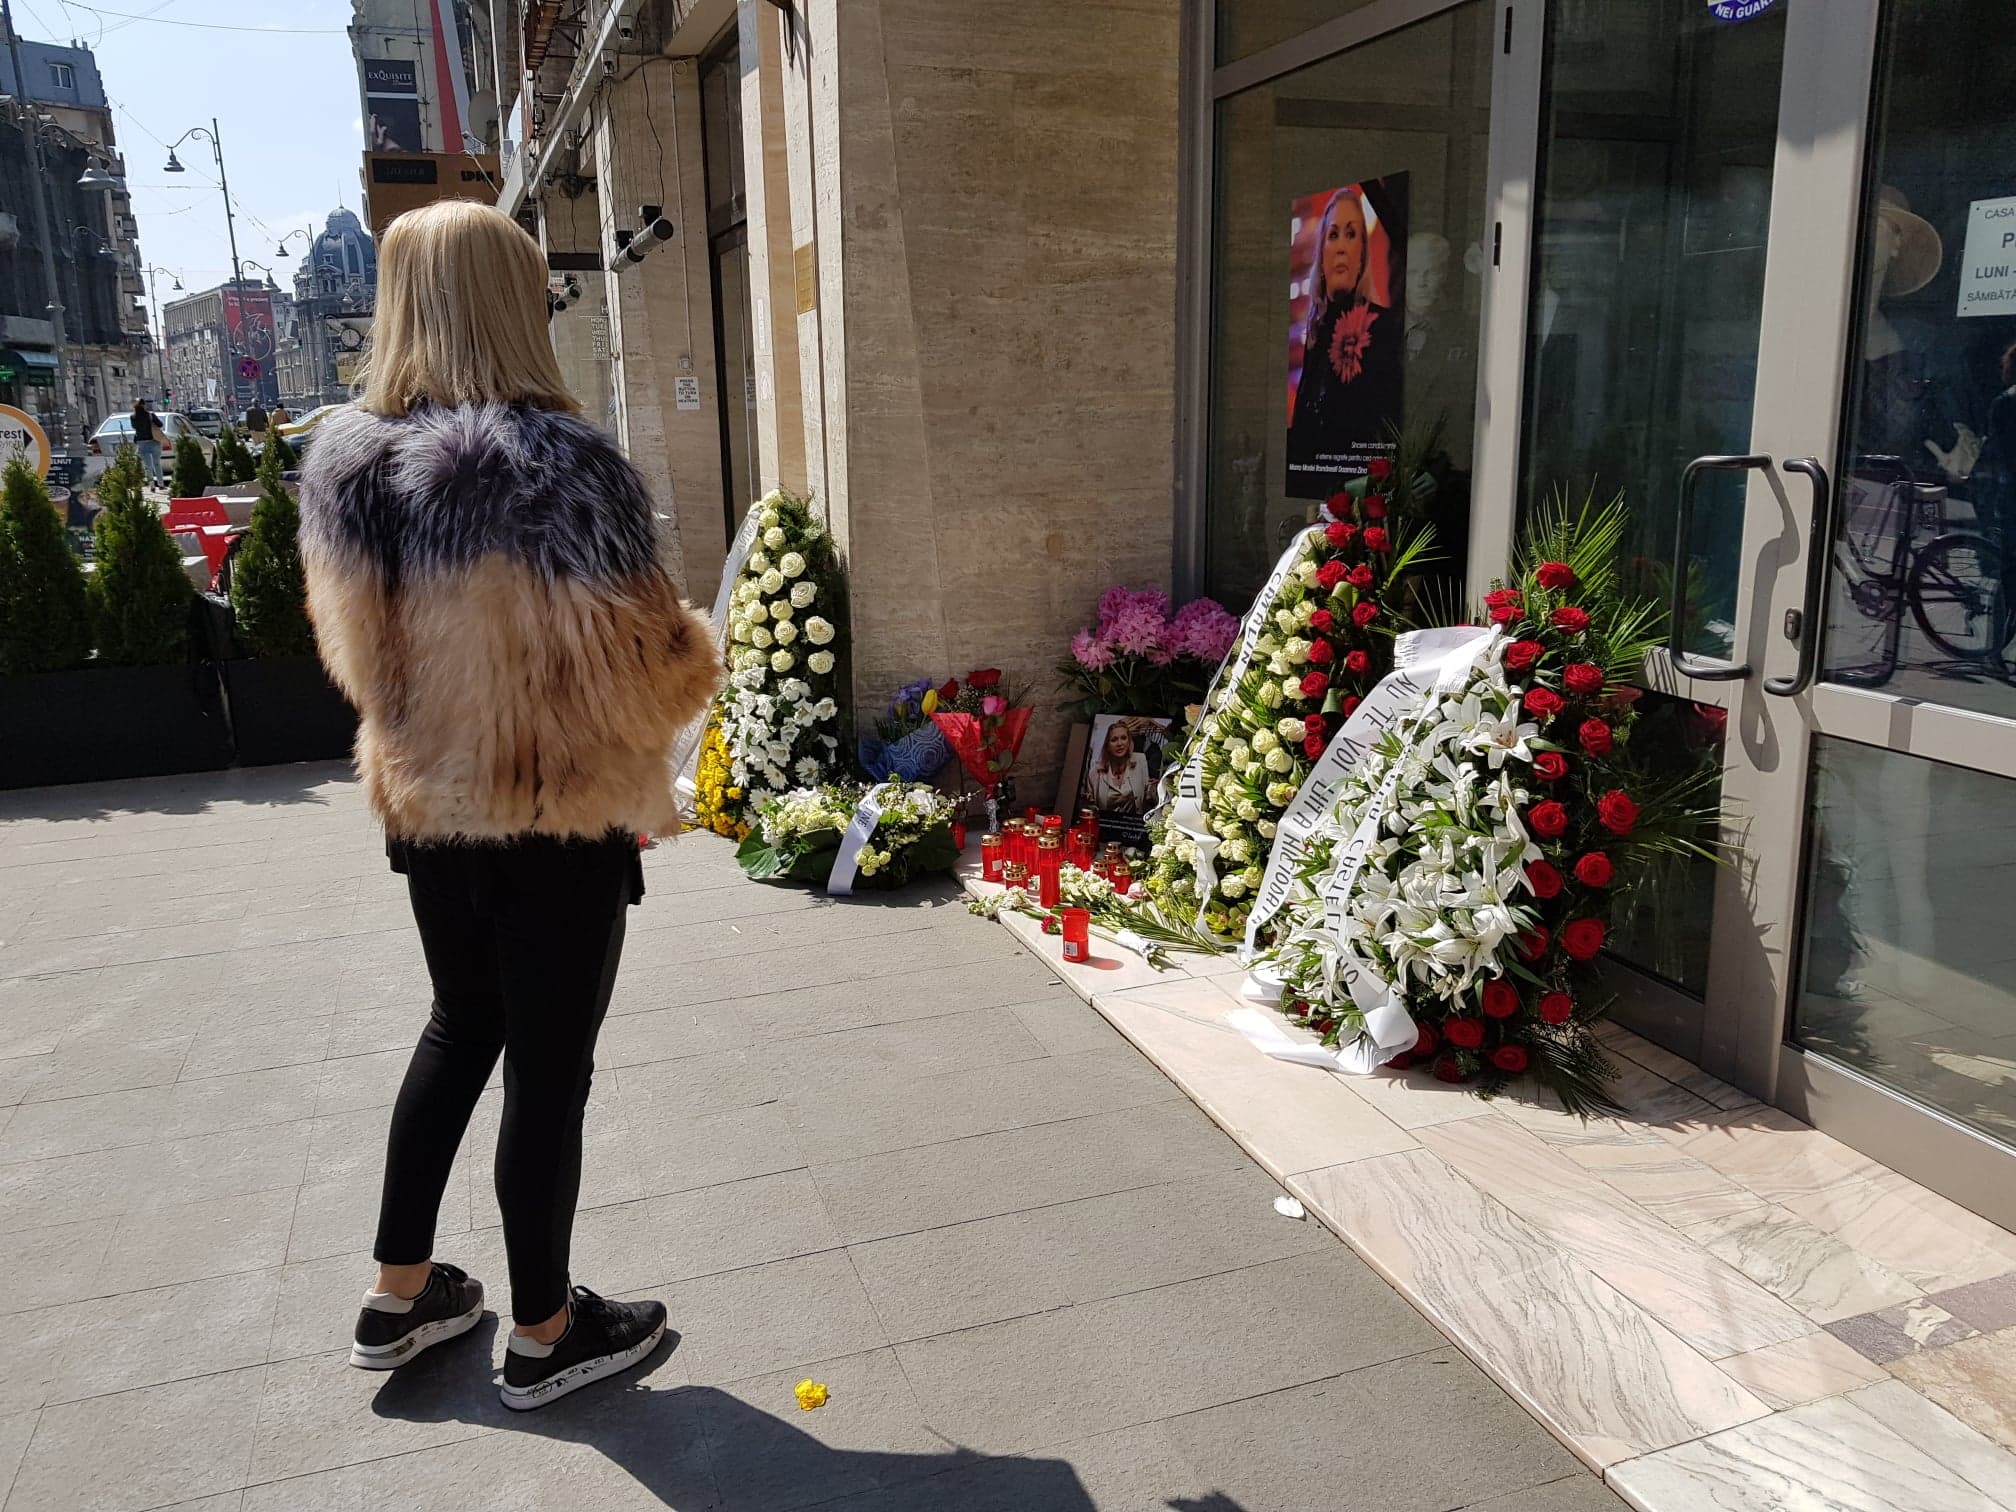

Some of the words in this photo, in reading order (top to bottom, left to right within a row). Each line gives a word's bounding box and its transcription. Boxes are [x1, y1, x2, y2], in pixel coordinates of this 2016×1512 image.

[368, 69, 412, 81] EXQUISITE
[1984, 207, 2015, 220] CASA
[1975, 265, 2009, 279] LUNI
[1386, 671, 1421, 700] NU
[1362, 704, 1397, 731] TE
[1332, 737, 1367, 773] VOI
